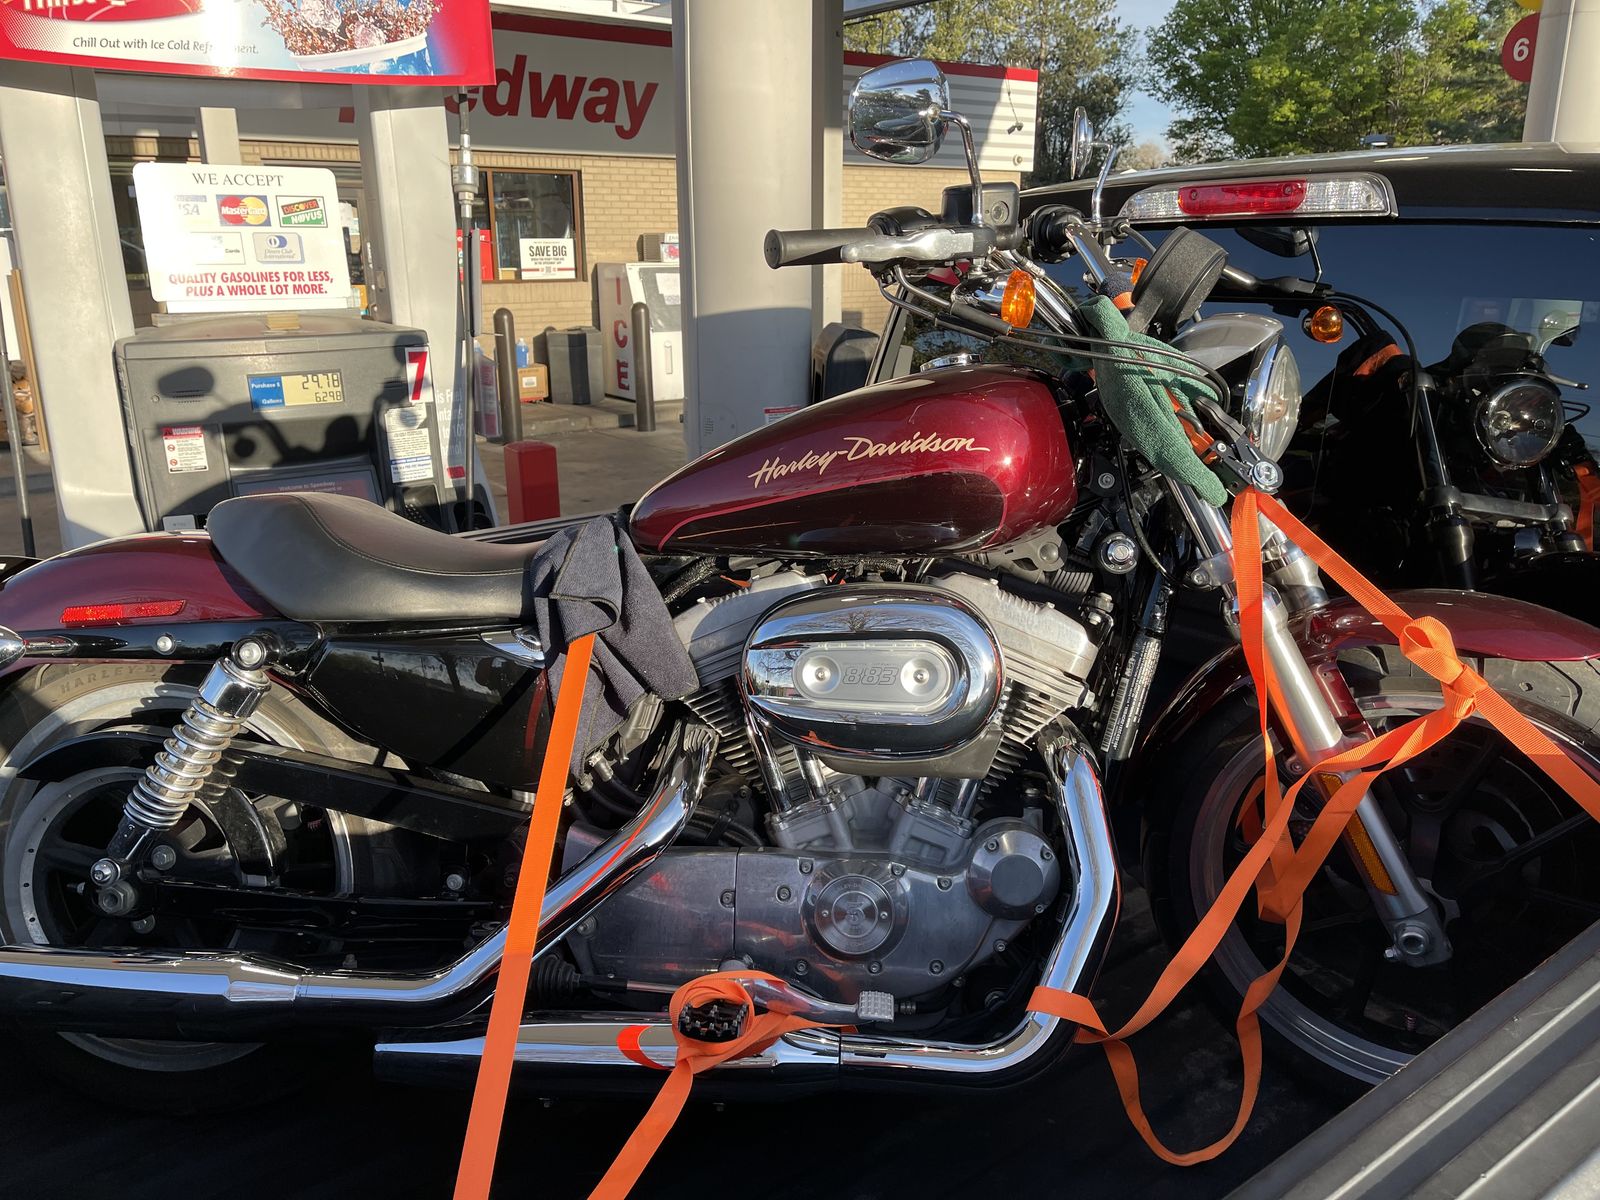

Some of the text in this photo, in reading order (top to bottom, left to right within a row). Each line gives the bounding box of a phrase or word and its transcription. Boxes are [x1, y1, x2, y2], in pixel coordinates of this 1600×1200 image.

[72, 36, 260, 54] Chill Out with Ice Cold Refent.
[1513, 37, 1530, 62] 6
[443, 54, 659, 140] dway
[192, 172, 284, 187] WE ACCEPT
[283, 200, 319, 214] DISCOVER
[291, 210, 323, 224] NOVUS
[529, 245, 568, 257] SAVE BIG
[168, 270, 334, 285] QUALITY GASOLINES FOR LESS,
[186, 283, 328, 297] PLUS A WHOLE LOT MORE.
[302, 373, 341, 390] 29.78
[408, 351, 428, 401] 7
[748, 431, 991, 488] Harley-Davidson
[842, 667, 900, 685] 883
